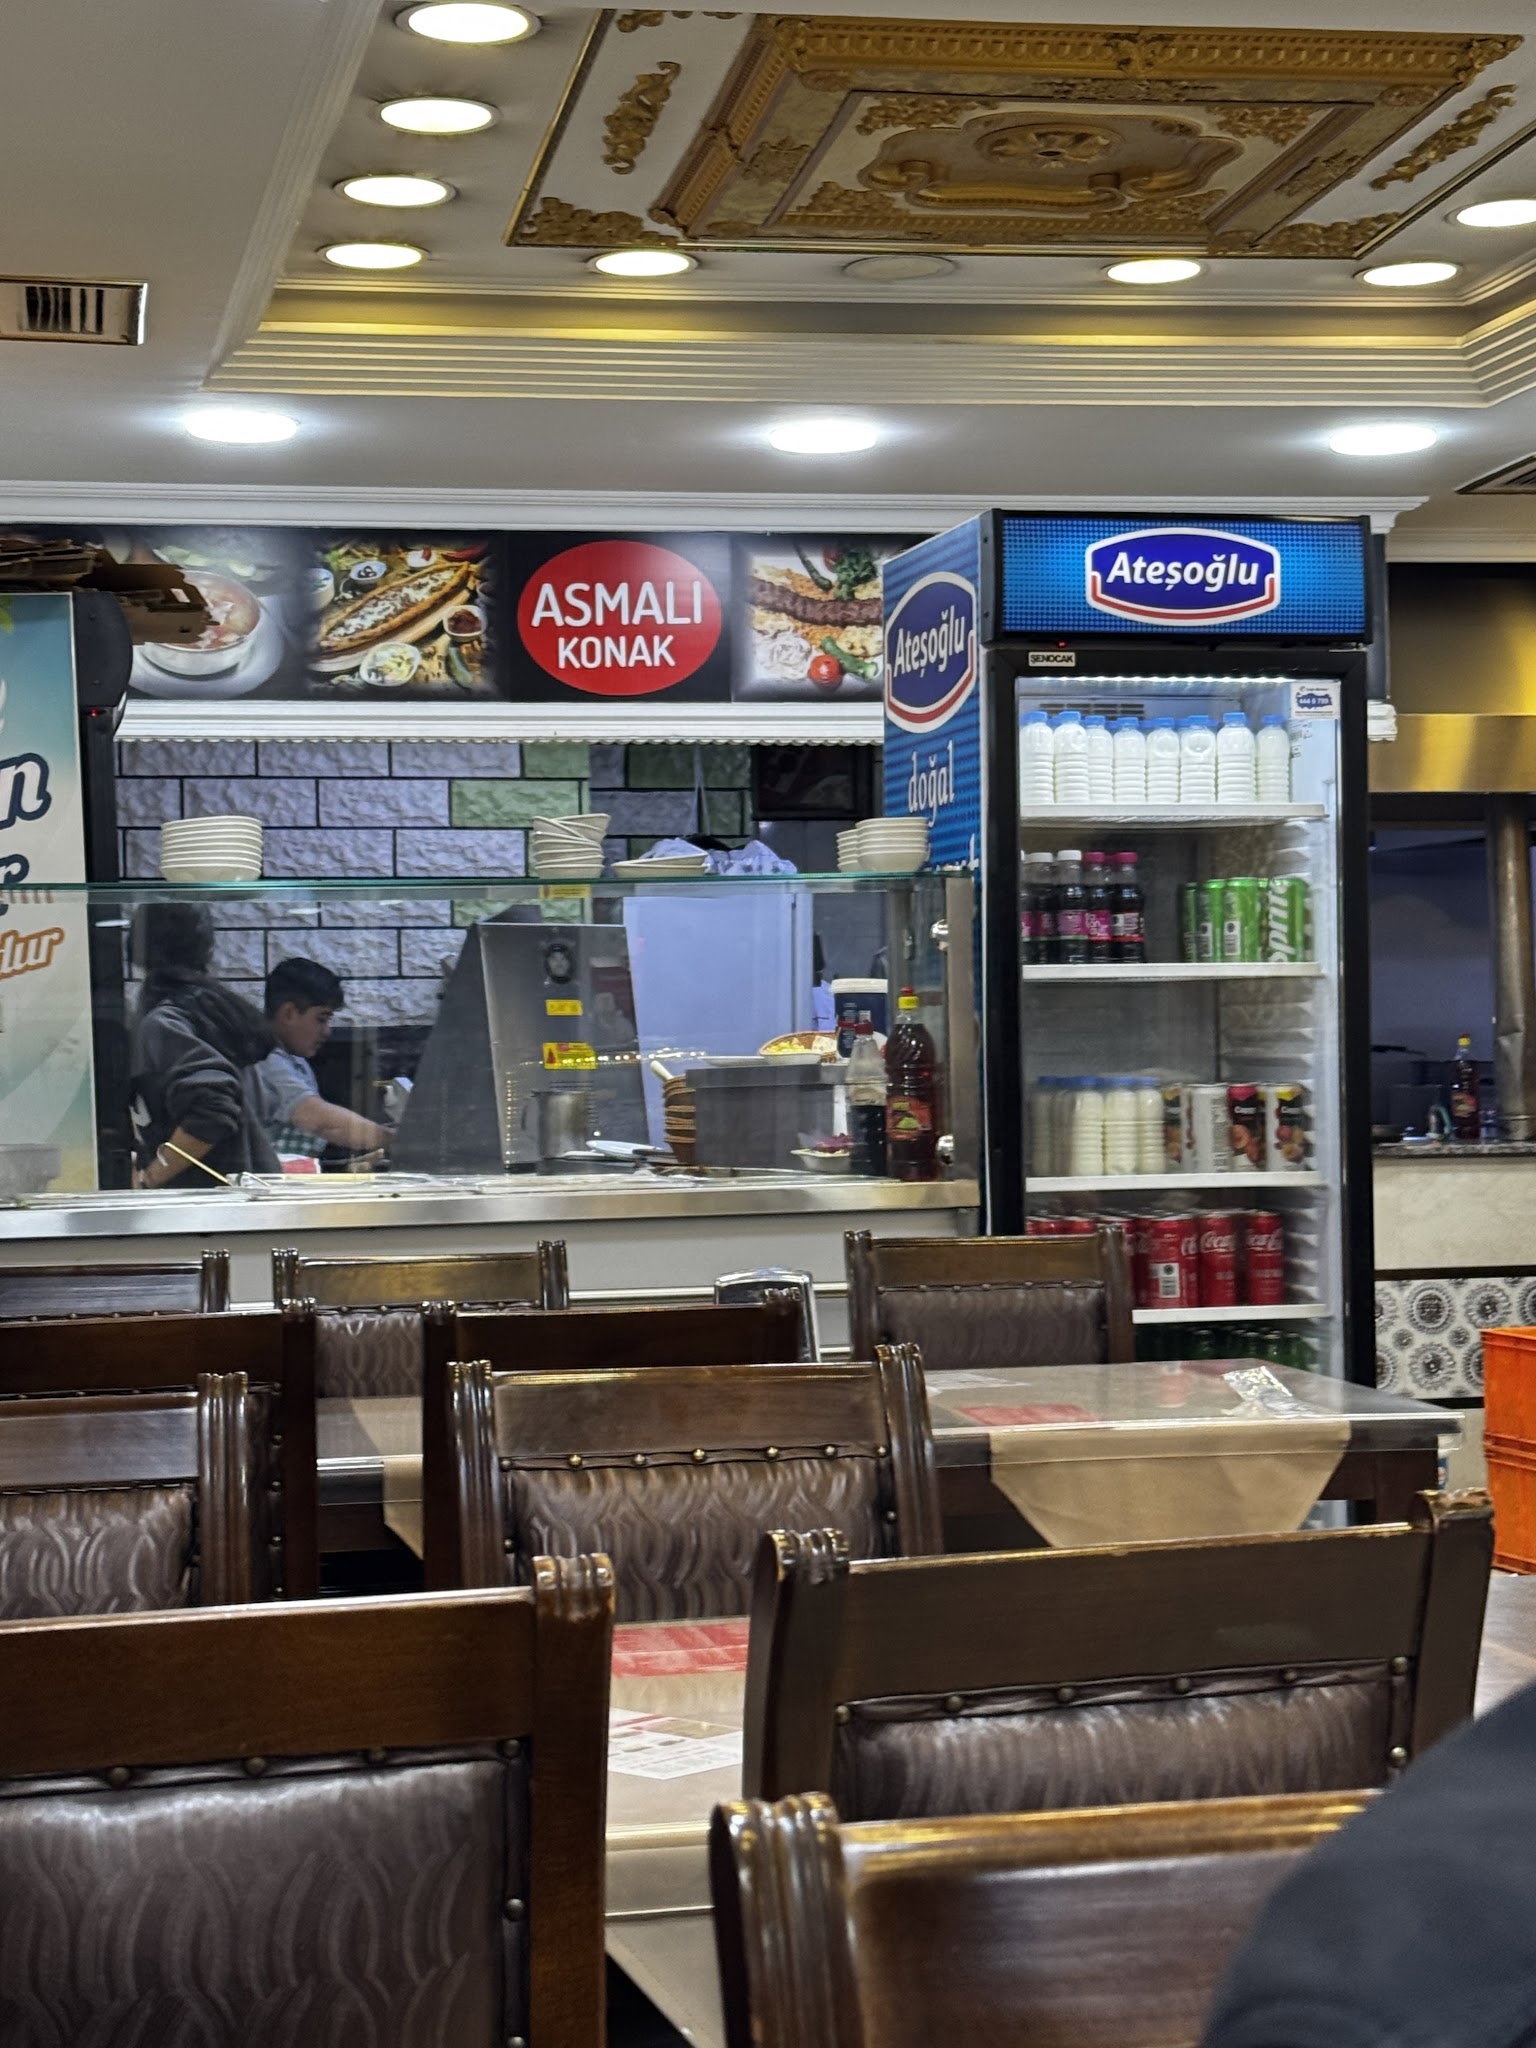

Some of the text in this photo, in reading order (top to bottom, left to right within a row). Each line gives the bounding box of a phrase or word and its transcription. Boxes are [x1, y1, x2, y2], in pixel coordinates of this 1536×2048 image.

[1106, 551, 1260, 593] Ateşoğlu
[531, 580, 702, 628] ASMALI
[557, 634, 676, 670] KONAK
[893, 604, 966, 679] Ateşoğlu
[1030, 654, 1074, 664] ŞENOCAK
[908, 739, 955, 828] doğal
